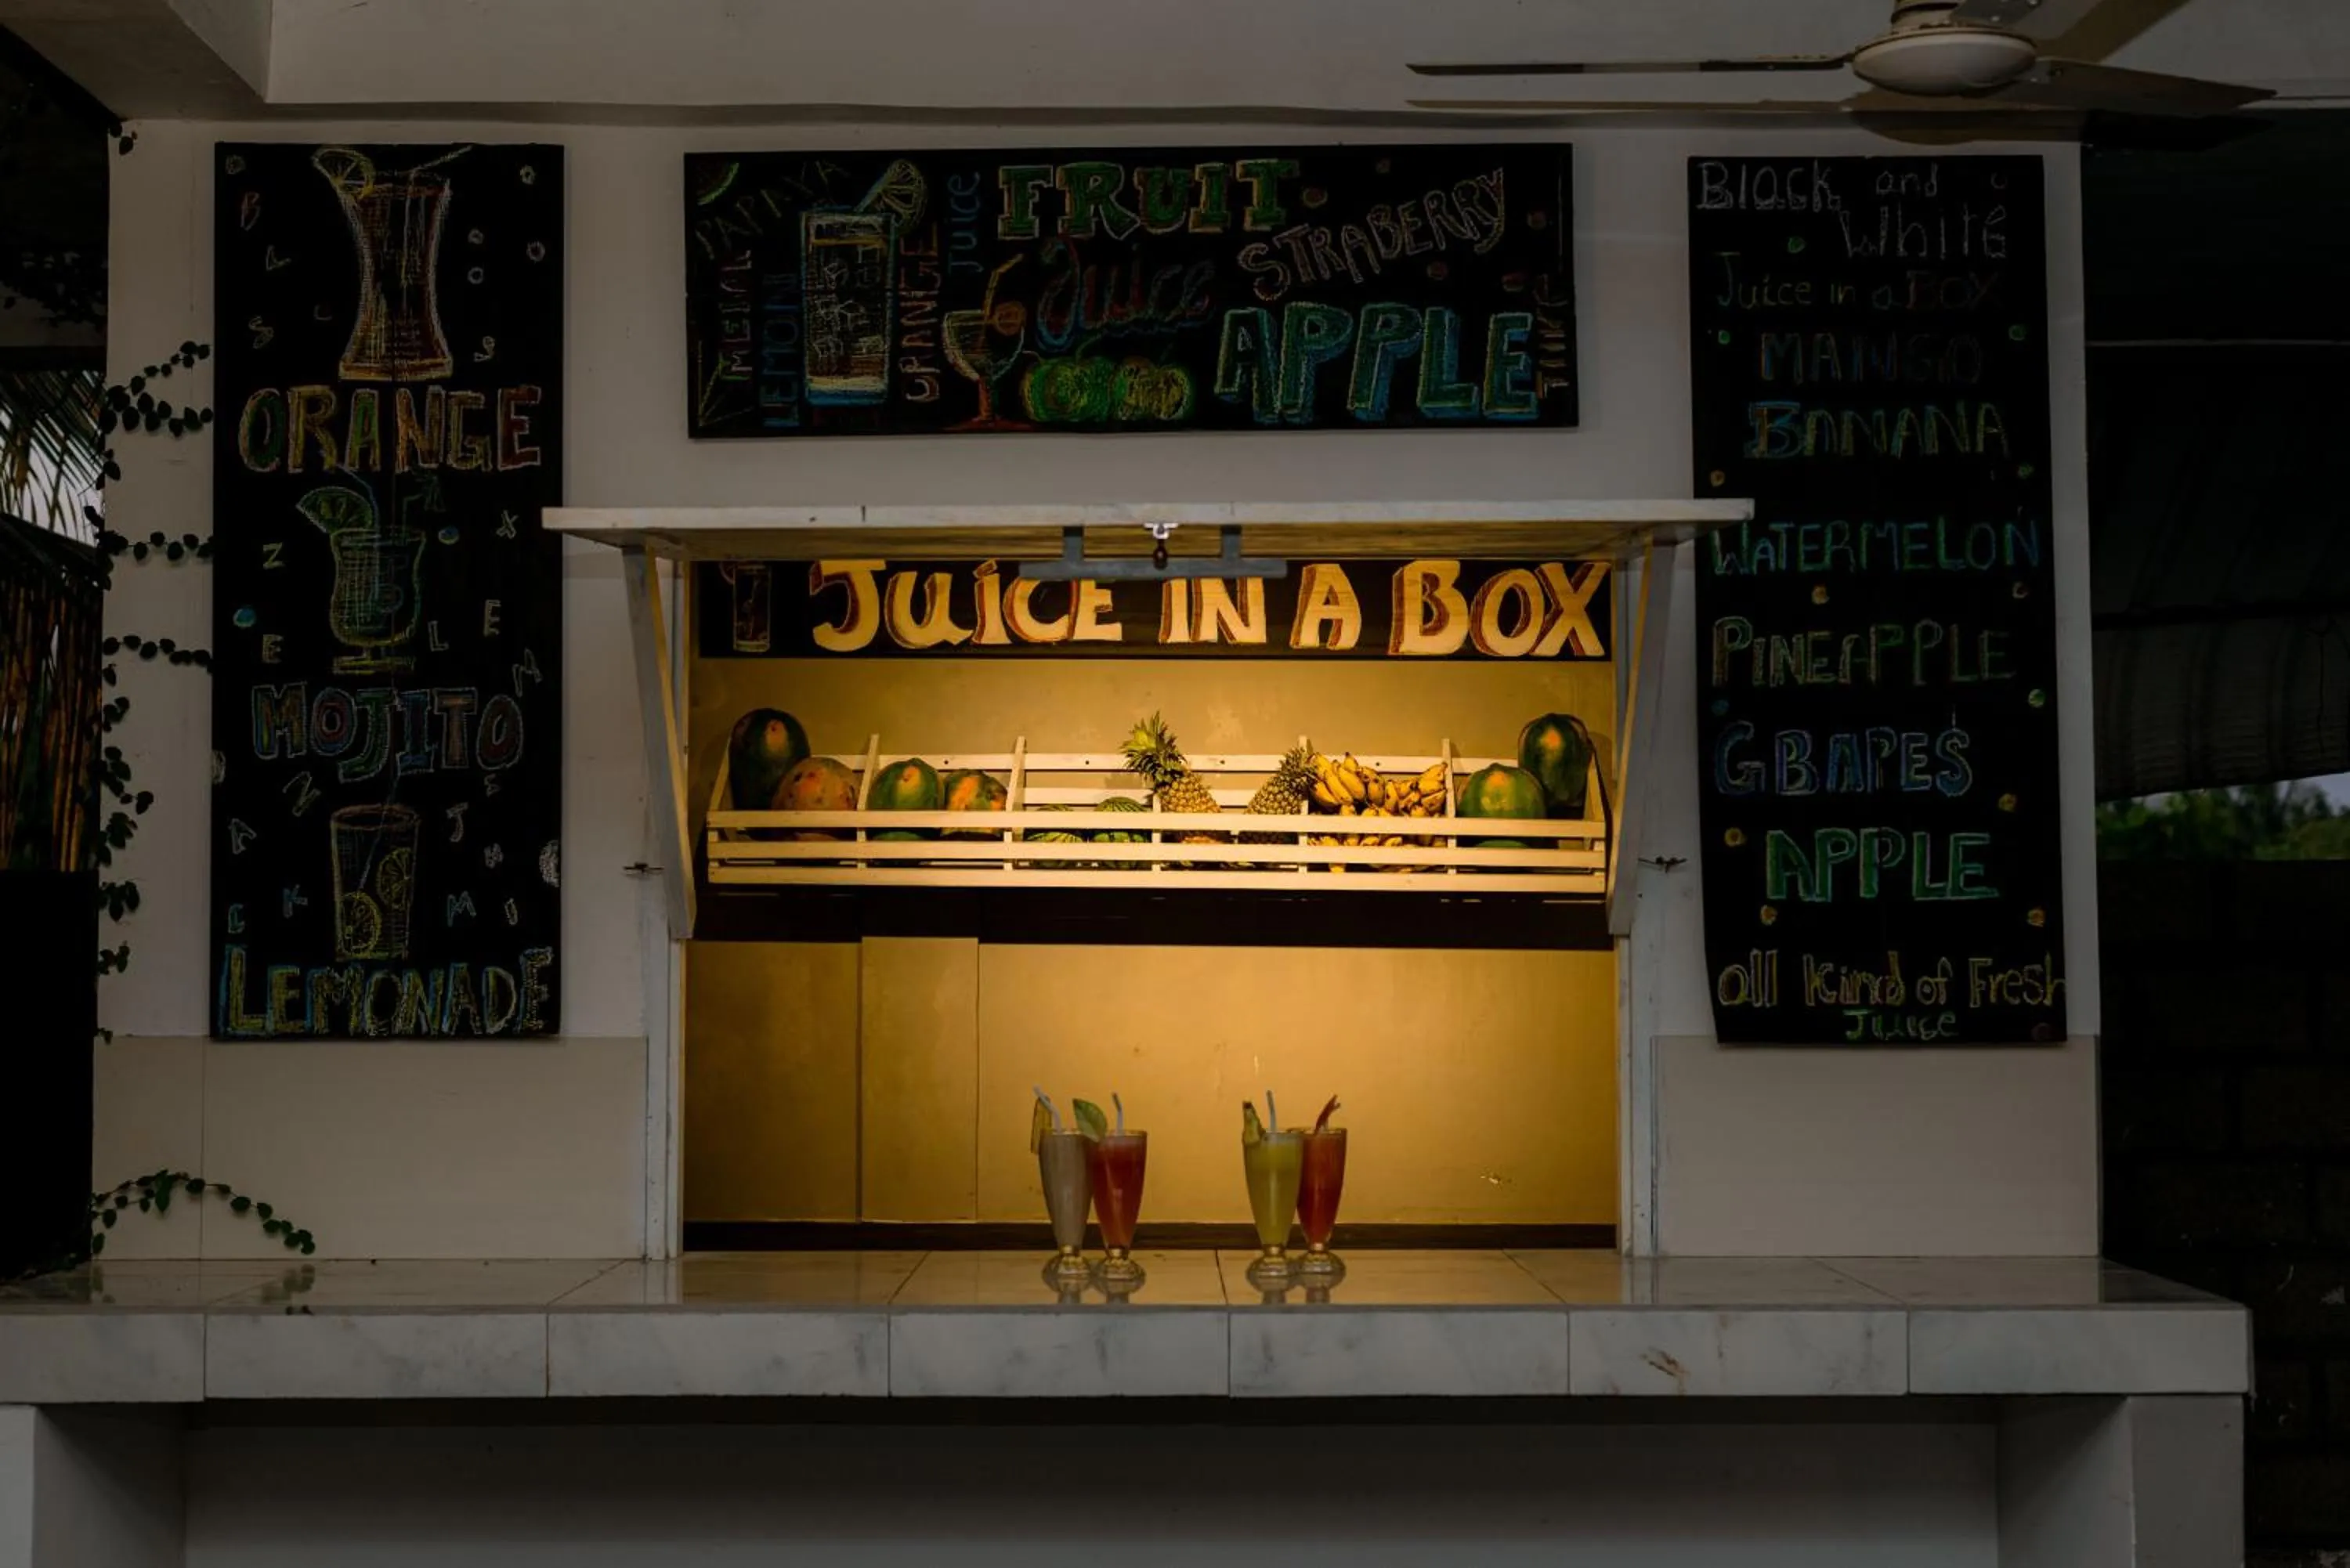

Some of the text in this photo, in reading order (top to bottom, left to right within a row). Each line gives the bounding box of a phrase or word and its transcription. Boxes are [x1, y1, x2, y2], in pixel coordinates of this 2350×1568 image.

[997, 159, 1301, 241] FRUIT
[1875, 161, 1940, 198] and
[1236, 166, 1506, 302] STRABERRY
[1712, 251, 1813, 310] Juice
[1830, 280, 1856, 307] in
[1213, 300, 1542, 427] APPLE
[1757, 331, 1984, 385] MANGO
[237, 383, 544, 473] ORANGE
[1743, 396, 2012, 461] BANANA
[1707, 514, 2044, 578] WATERMELON
[1157, 576, 1267, 645] IN
[1289, 562, 1362, 651] A
[1386, 558, 1612, 657] BOX
[1711, 616, 2018, 688] PINEAPPLE
[250, 680, 526, 784] MOJITO
[1764, 825, 2001, 904] APPLE
[219, 942, 554, 1037] LEMONADE
[1915, 956, 1954, 1007] of
[1967, 950, 2066, 1009] Fresh
